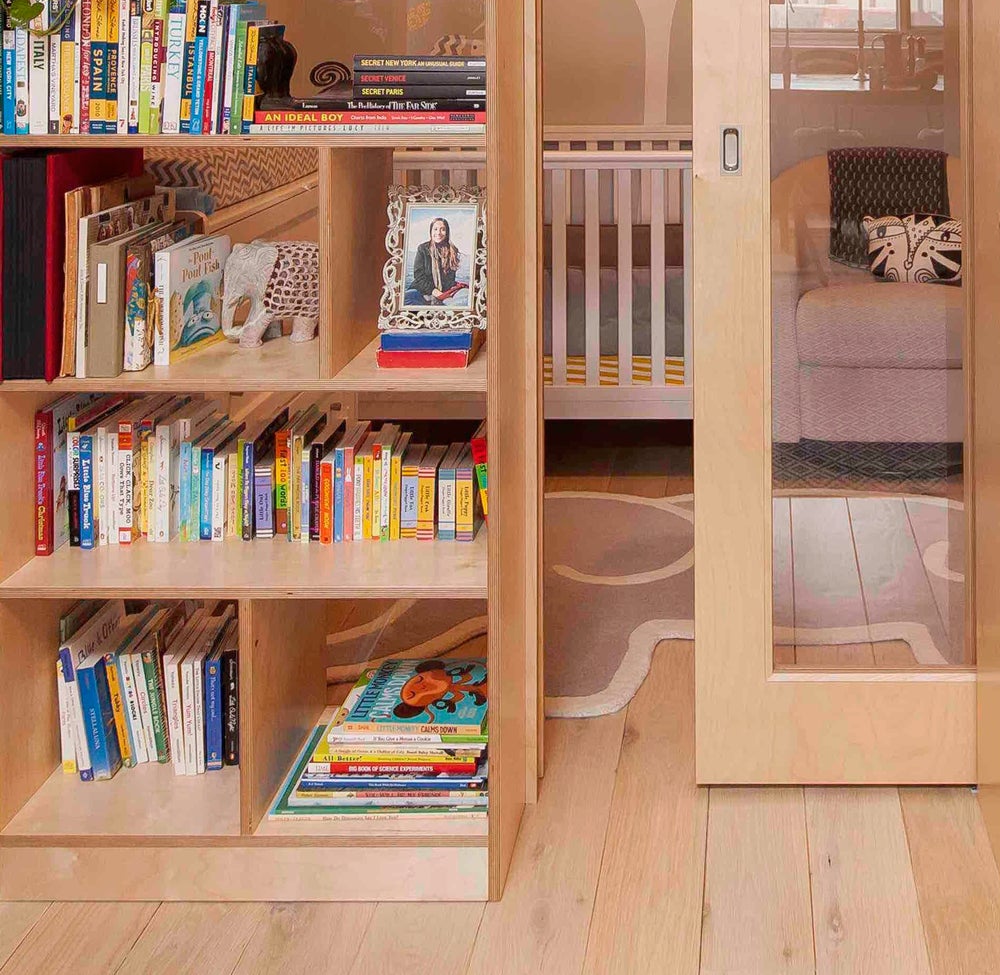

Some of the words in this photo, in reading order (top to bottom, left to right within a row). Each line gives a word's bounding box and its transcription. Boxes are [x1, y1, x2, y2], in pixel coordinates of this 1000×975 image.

[34, 41, 44, 69] ITALY
[167, 19, 182, 80] TURKEY
[93, 49, 103, 91] SPAIN
[185, 45, 194, 96] ISTANBUL
[361, 59, 384, 67] SECRET
[386, 59, 399, 67] NEW
[362, 88, 384, 96] SECRET
[265, 113, 283, 122] AN
[285, 113, 317, 121] IDEAL
[321, 113, 344, 121] BOY
[82, 459, 91, 482] Little
[279, 450, 287, 467] first
[83, 484, 91, 502] Blue
[279, 484, 287, 508] words
[37, 505, 46, 541] Christmas
[83, 503, 91, 529] Truck
[140, 691, 148, 714] Circles
[172, 699, 180, 730] Triangles
[89, 708, 101, 750] STELLALUNA
